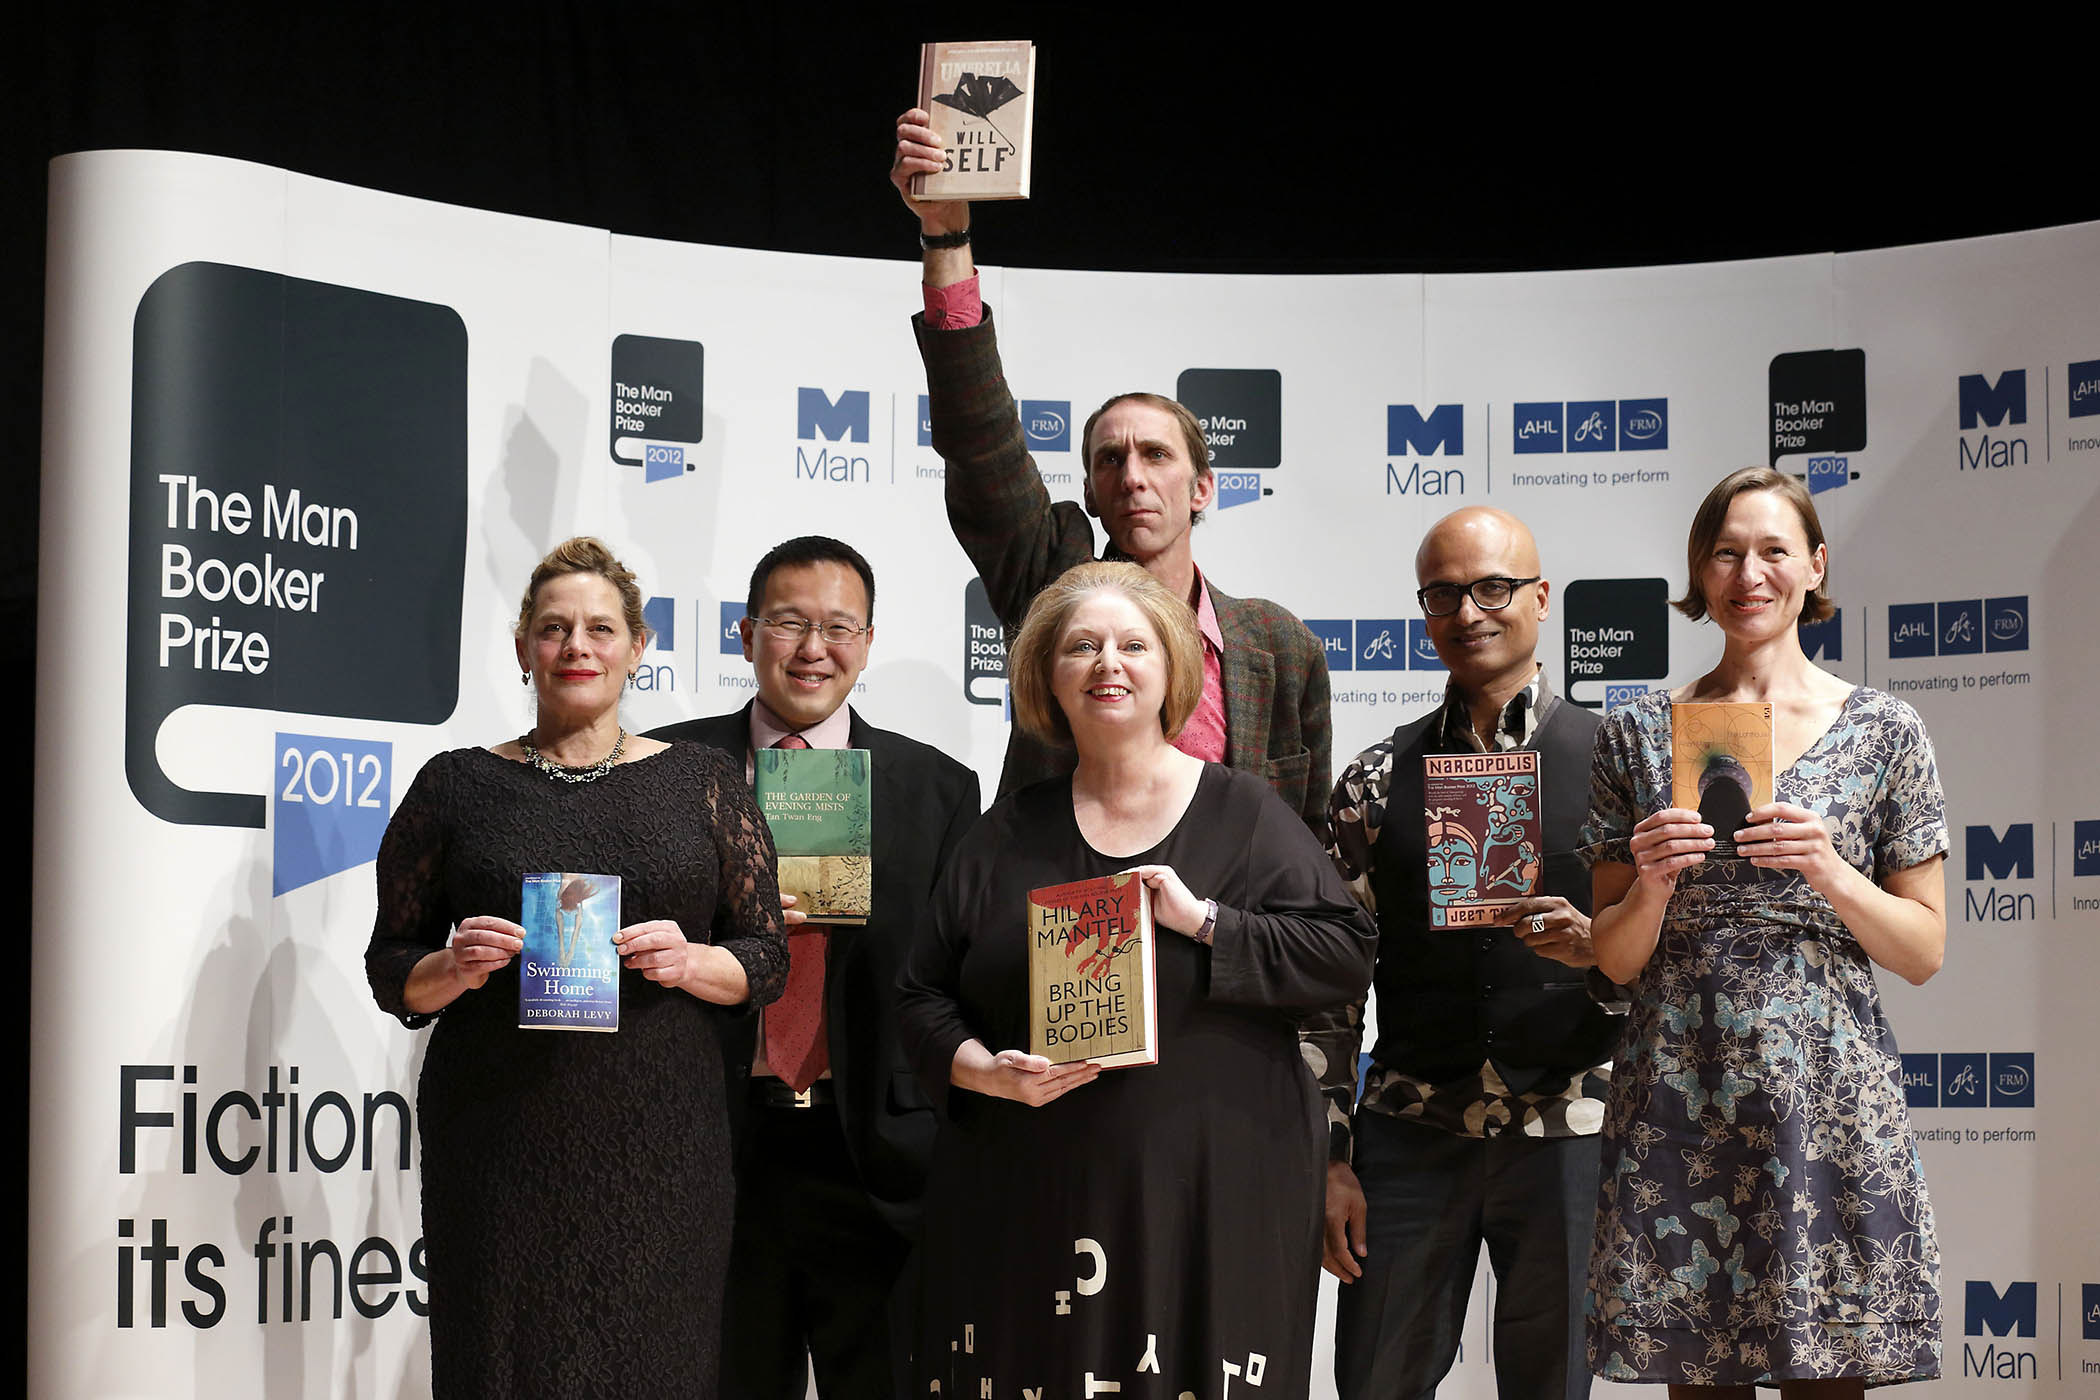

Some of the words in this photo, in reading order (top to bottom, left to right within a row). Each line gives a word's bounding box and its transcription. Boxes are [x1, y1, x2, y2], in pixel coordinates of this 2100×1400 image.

[957, 131, 996, 145] WILL
[943, 147, 1009, 172] SELF
[616, 383, 639, 398] The
[641, 386, 672, 401] Man
[616, 400, 662, 417] Booker
[1775, 403, 1799, 416] The
[1802, 401, 1834, 414] Man
[615, 415, 644, 432] Prize
[1032, 420, 1059, 431] FRM
[1212, 416, 1246, 430] Man
[1522, 420, 1558, 436] AHL
[1629, 419, 1657, 431] FRM
[1775, 418, 1823, 432] Booker
[1205, 431, 1235, 445] oker
[1775, 434, 1806, 448] Prize
[648, 448, 681, 464] 2012
[1960, 435, 2028, 471] Man
[797, 446, 869, 482] Man
[1811, 460, 1845, 474] 2012
[1220, 476, 1257, 490] 2012
[1387, 462, 1464, 495] Man
[1512, 472, 1588, 488] Innovating
[1593, 472, 1607, 484] to
[1612, 469, 1670, 486] perform
[159, 474, 251, 535] The
[264, 484, 357, 550] Man
[161, 544, 324, 612] Booker
[970, 625, 997, 639] The
[1897, 623, 1930, 639] AHL
[1994, 618, 2018, 630] FRM
[1570, 629, 1596, 642] The
[1599, 628, 1634, 641] Man
[159, 613, 270, 674] Prize
[971, 641, 1007, 656] Book
[1325, 637, 1347, 651] HL
[1419, 639, 1436, 650] FR
[1571, 645, 1623, 658] Booker
[971, 656, 1004, 671] Prize
[1571, 660, 1603, 674] Prize
[635, 664, 674, 692] an
[719, 673, 759, 689] Innova
[1889, 676, 1958, 691] Innovating
[1963, 676, 1975, 688] to
[1980, 672, 2030, 689] perform
[1331, 690, 1377, 706] vating
[1382, 690, 1397, 702] to
[1402, 690, 1446, 705] perfor
[282, 748, 382, 808] 2012
[765, 792, 786, 801] THE
[790, 792, 833, 801] GARDEN
[836, 793, 851, 802] OF
[765, 802, 812, 811] EVENING
[816, 803, 844, 811] MISTS
[783, 813, 804, 821] Twan
[807, 814, 822, 822] Eng
[1043, 895, 1124, 926] HILARY
[1966, 887, 2034, 922] Man
[1038, 917, 1131, 948] MANTEL
[527, 962, 611, 983] Swimming
[544, 980, 594, 996] Home
[1050, 974, 1121, 1003] BRING
[527, 1009, 580, 1018] DEBORAH
[584, 1010, 611, 1020] LEVY
[1047, 1003, 1076, 1024] UP
[1080, 995, 1126, 1018] THE
[1046, 1016, 1129, 1047] BODIES
[2000, 1074, 2024, 1086] FRM
[119, 1065, 411, 1176] Fiction
[1914, 1128, 1961, 1144] ovating
[1966, 1129, 1978, 1141] to
[1984, 1128, 2036, 1144] perform
[117, 1218, 227, 1329] its
[254, 1216, 430, 1324] fines
[1964, 1343, 2036, 1379] Man
